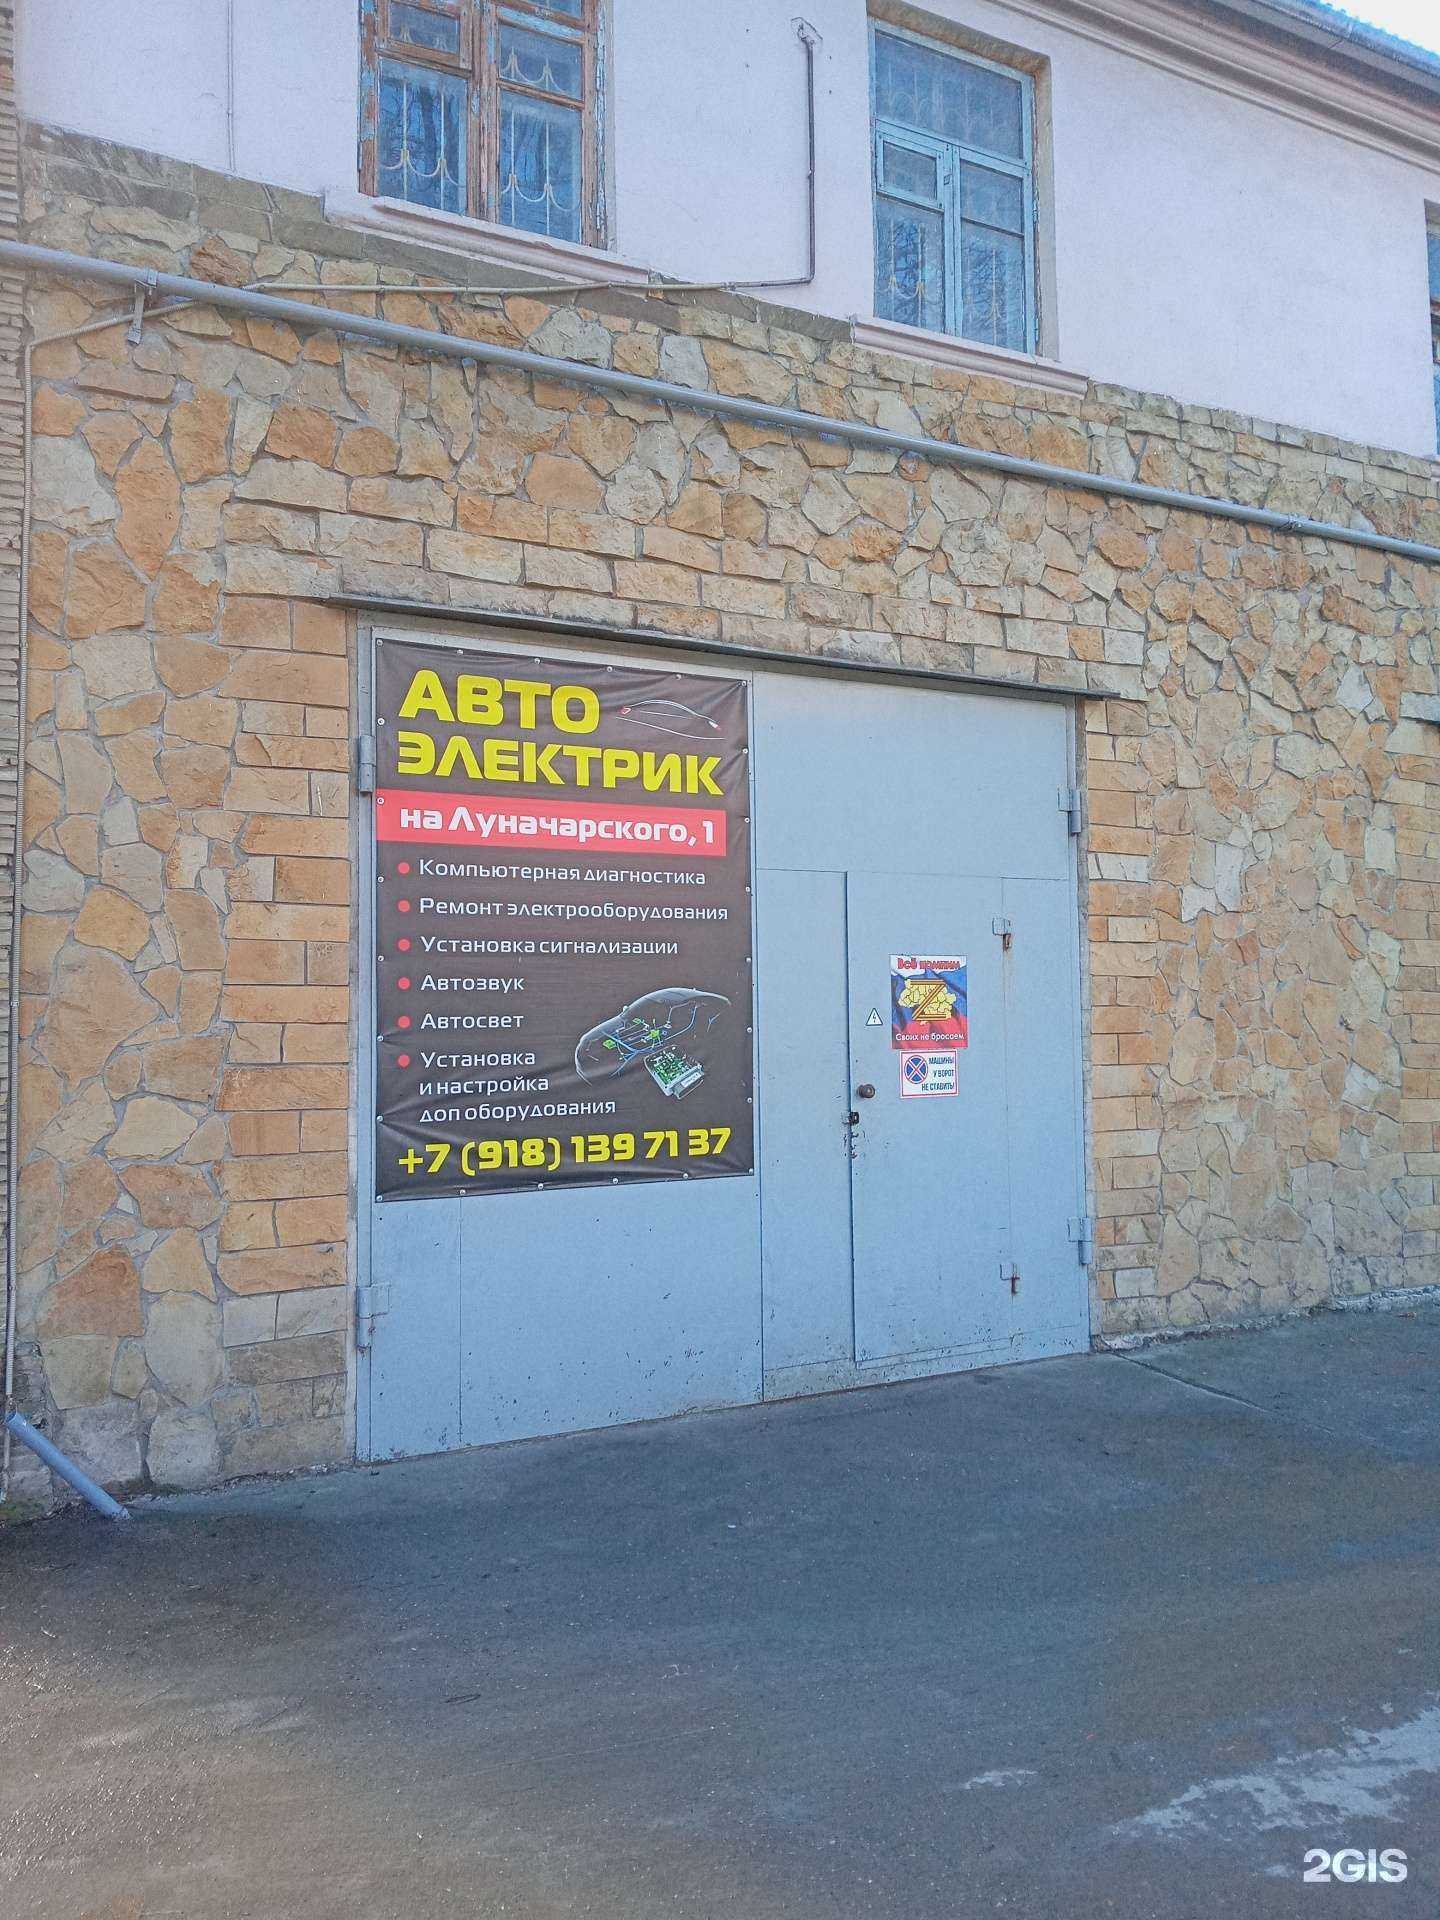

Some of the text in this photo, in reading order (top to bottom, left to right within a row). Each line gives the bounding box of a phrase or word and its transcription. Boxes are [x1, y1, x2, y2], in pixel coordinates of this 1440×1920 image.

[399, 669, 600, 734] АВТО
[398, 730, 725, 796] ЭЛЕКТРИК
[400, 806, 715, 847] на Луначарского, 1
[419, 858, 706, 886] Компьютерная диагностика
[419, 897, 729, 922] Ремонт электрооборудования
[421, 935, 679, 956] Установка сигнализации
[420, 974, 525, 993] Автозвук
[420, 1013, 525, 1031] Автосвет
[895, 1033, 918, 1041] Своих
[421, 1051, 537, 1069] Установка
[928, 1056, 954, 1065] МАШИНЫ
[419, 1075, 550, 1096] и настройка
[921, 1083, 929, 1091] НЕ
[419, 1099, 617, 1124] доп оборудования
[399, 1127, 732, 1177] +7 (918) 139 71 37
